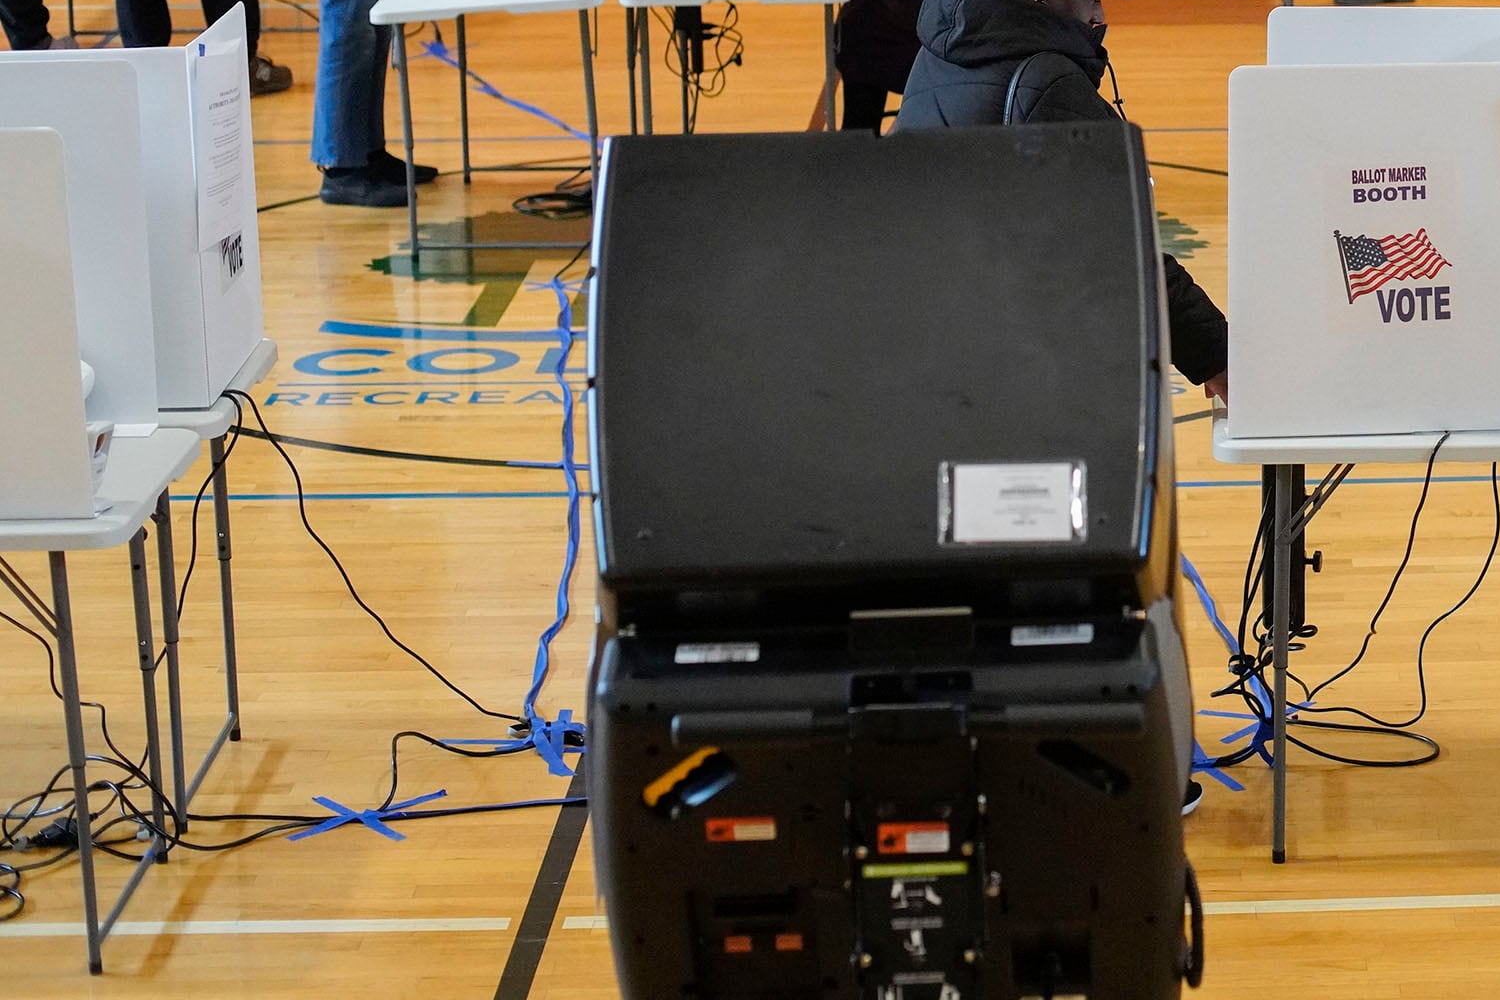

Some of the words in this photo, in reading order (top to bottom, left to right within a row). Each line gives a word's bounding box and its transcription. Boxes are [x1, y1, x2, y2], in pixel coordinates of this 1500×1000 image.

[1351, 168, 1386, 185] BALLOT
[1388, 166, 1427, 183] MARKER
[1353, 184, 1426, 203] BOOTH
[227, 234, 243, 278] VOTE
[1376, 286, 1451, 323] VOTE
